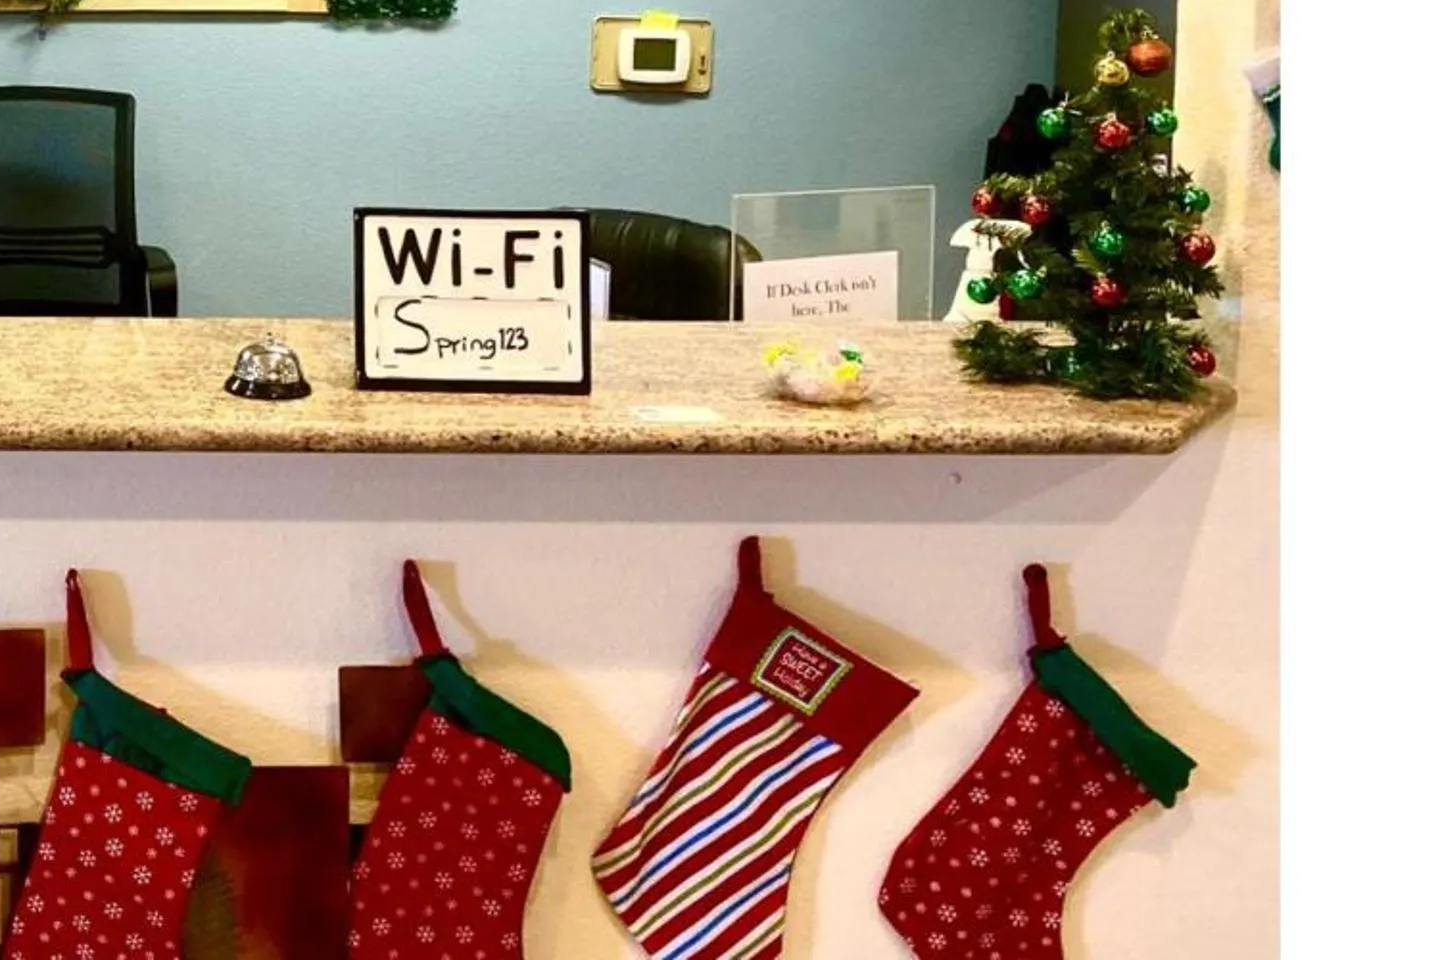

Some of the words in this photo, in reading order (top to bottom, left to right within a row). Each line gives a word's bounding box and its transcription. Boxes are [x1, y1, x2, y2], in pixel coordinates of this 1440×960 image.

[377, 226, 565, 289] Wi-Fi
[780, 280, 812, 298] Desk
[815, 277, 849, 295] Clerk
[828, 299, 850, 315] The
[393, 298, 530, 361] Spring123
[779, 651, 824, 681] SWEET
